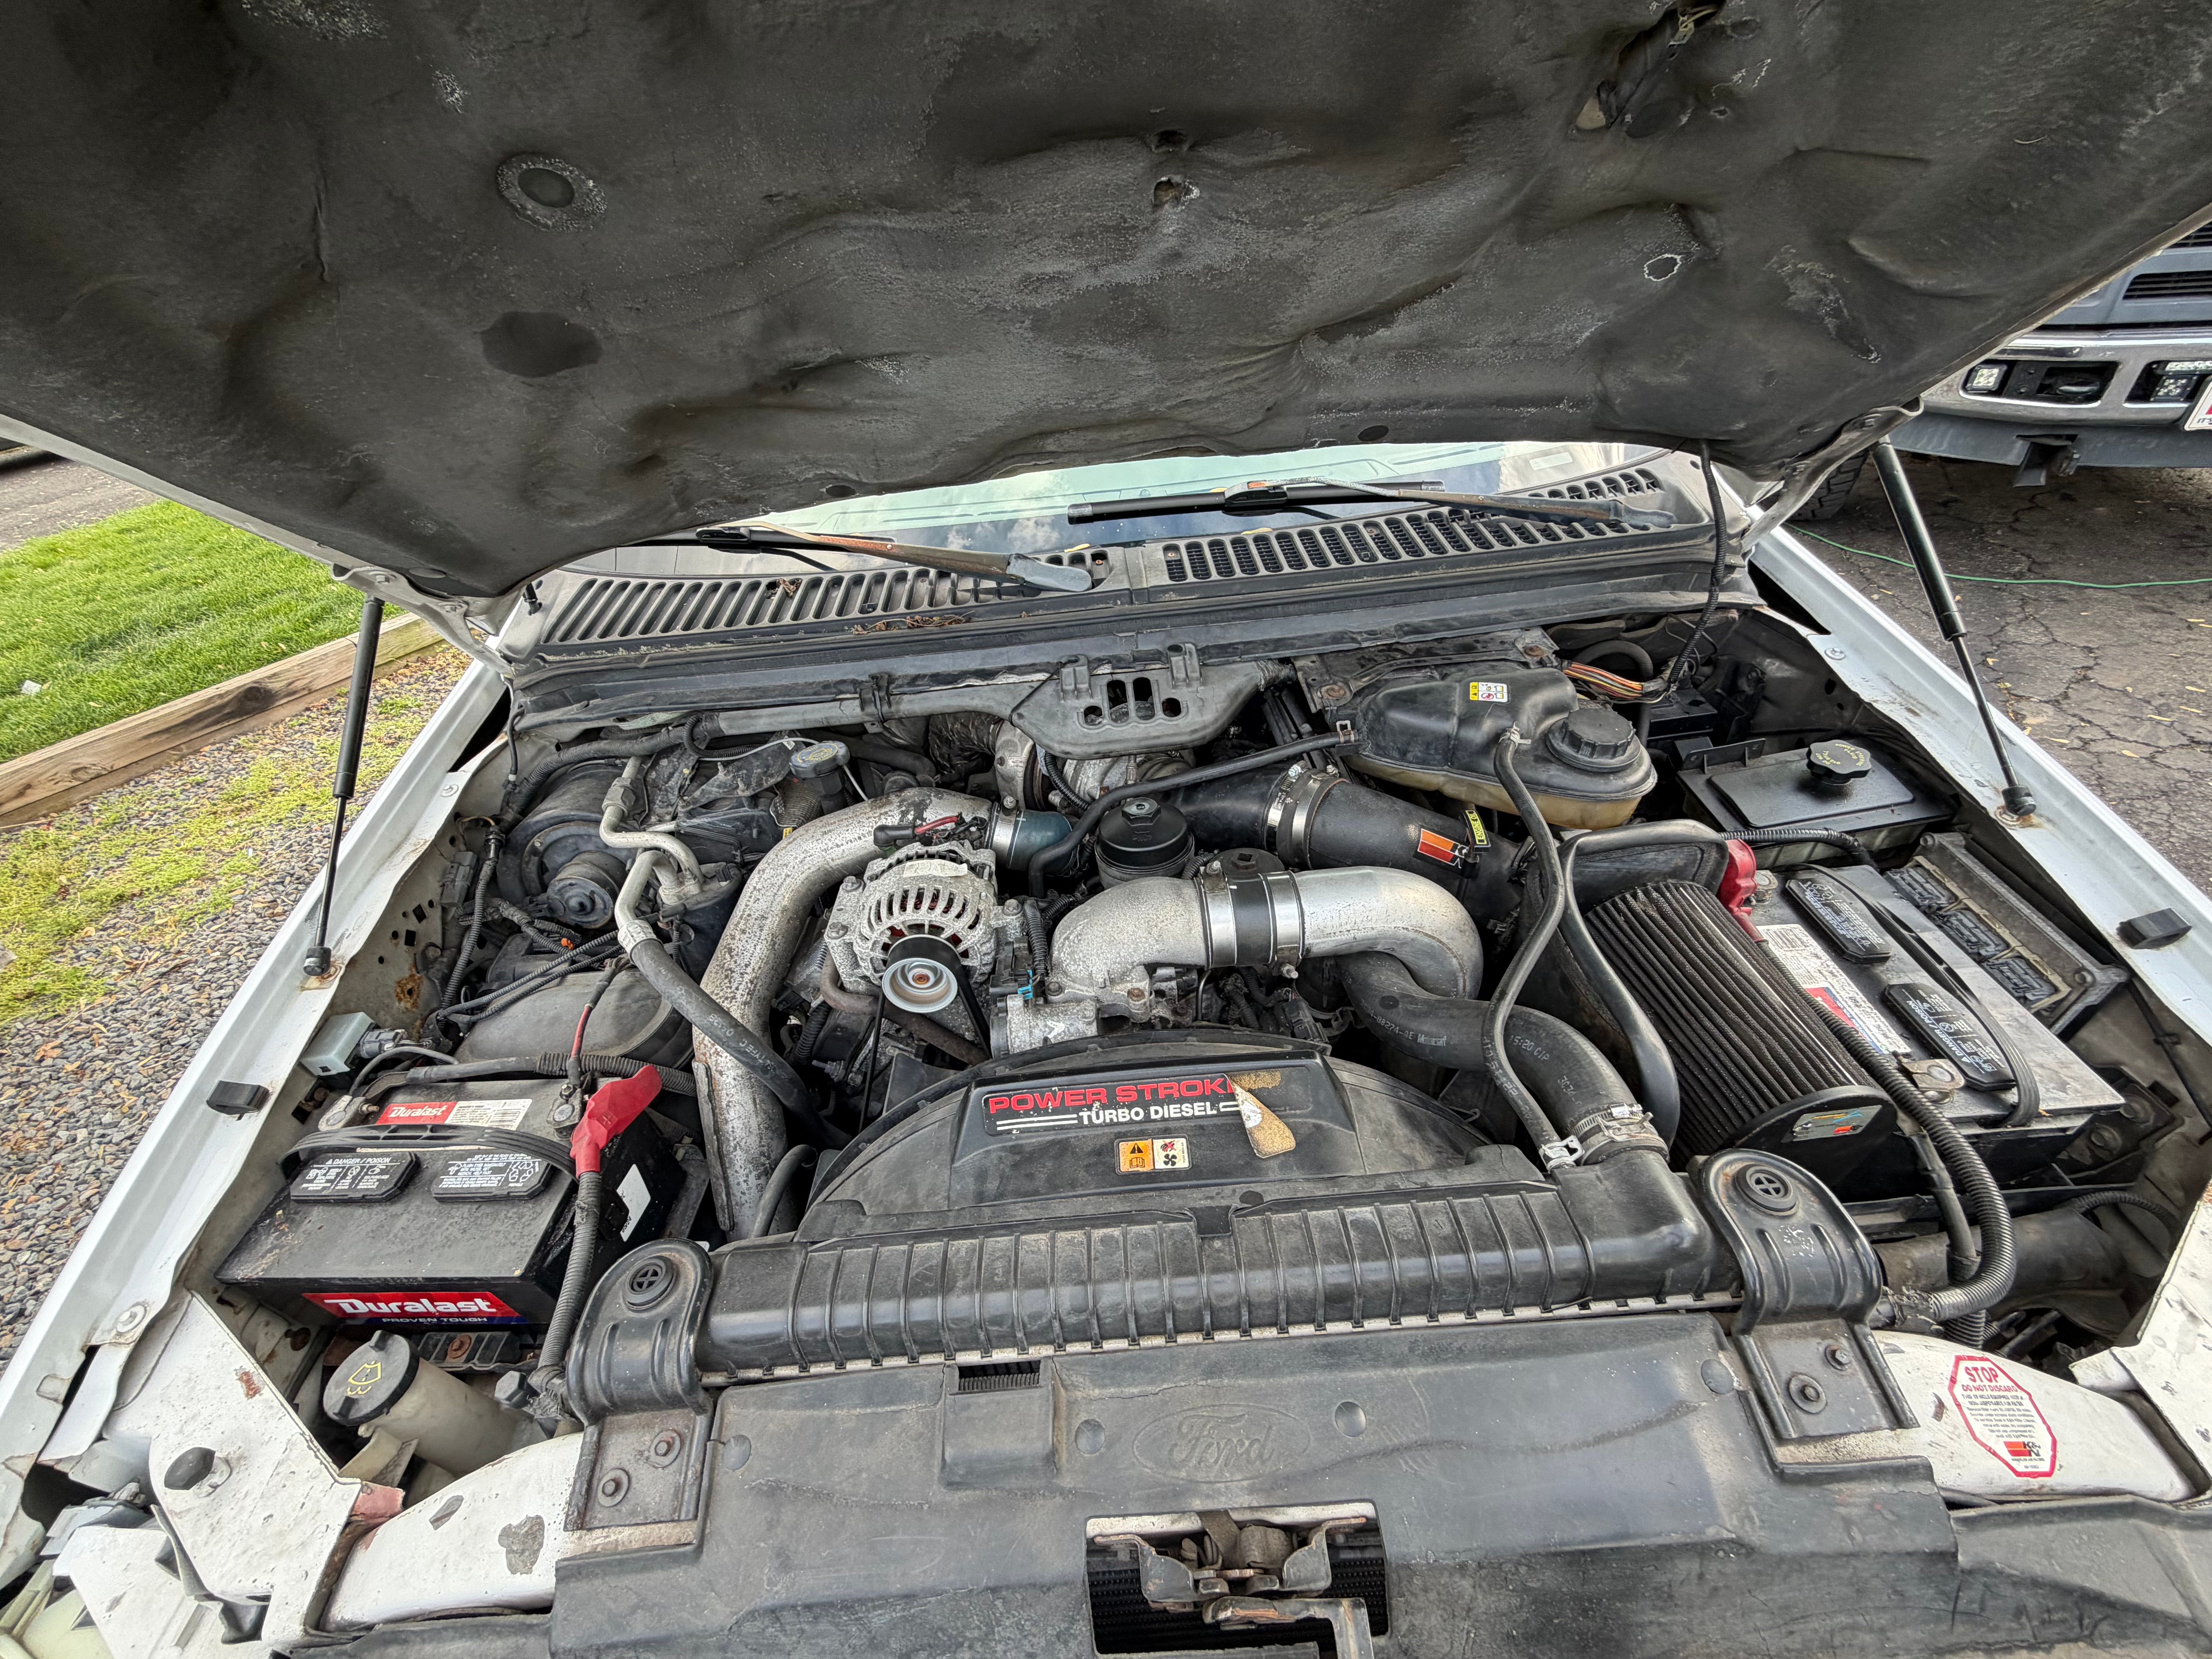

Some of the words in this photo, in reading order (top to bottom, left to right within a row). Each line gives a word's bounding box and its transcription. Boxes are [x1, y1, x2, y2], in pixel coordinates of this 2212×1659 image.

[1843, 749, 1858, 759] FLUID
[1472, 820, 1484, 839] ENGINE
[1906, 1000, 1933, 1024] POISON
[1934, 1029, 1963, 1056] DANGER
[1534, 1047, 1549, 1061] CIP
[989, 1087, 1108, 1114] POWER
[388, 1104, 448, 1118] Duralast
[1079, 1107, 1144, 1125] TURBO
[1150, 1101, 1218, 1119] DIESEL
[324, 1298, 497, 1313] Duralast
[1964, 1366, 1999, 1383] STOP
[1987, 1384, 2018, 1393] DISCARD
[1167, 1412, 1276, 1470] Ford
